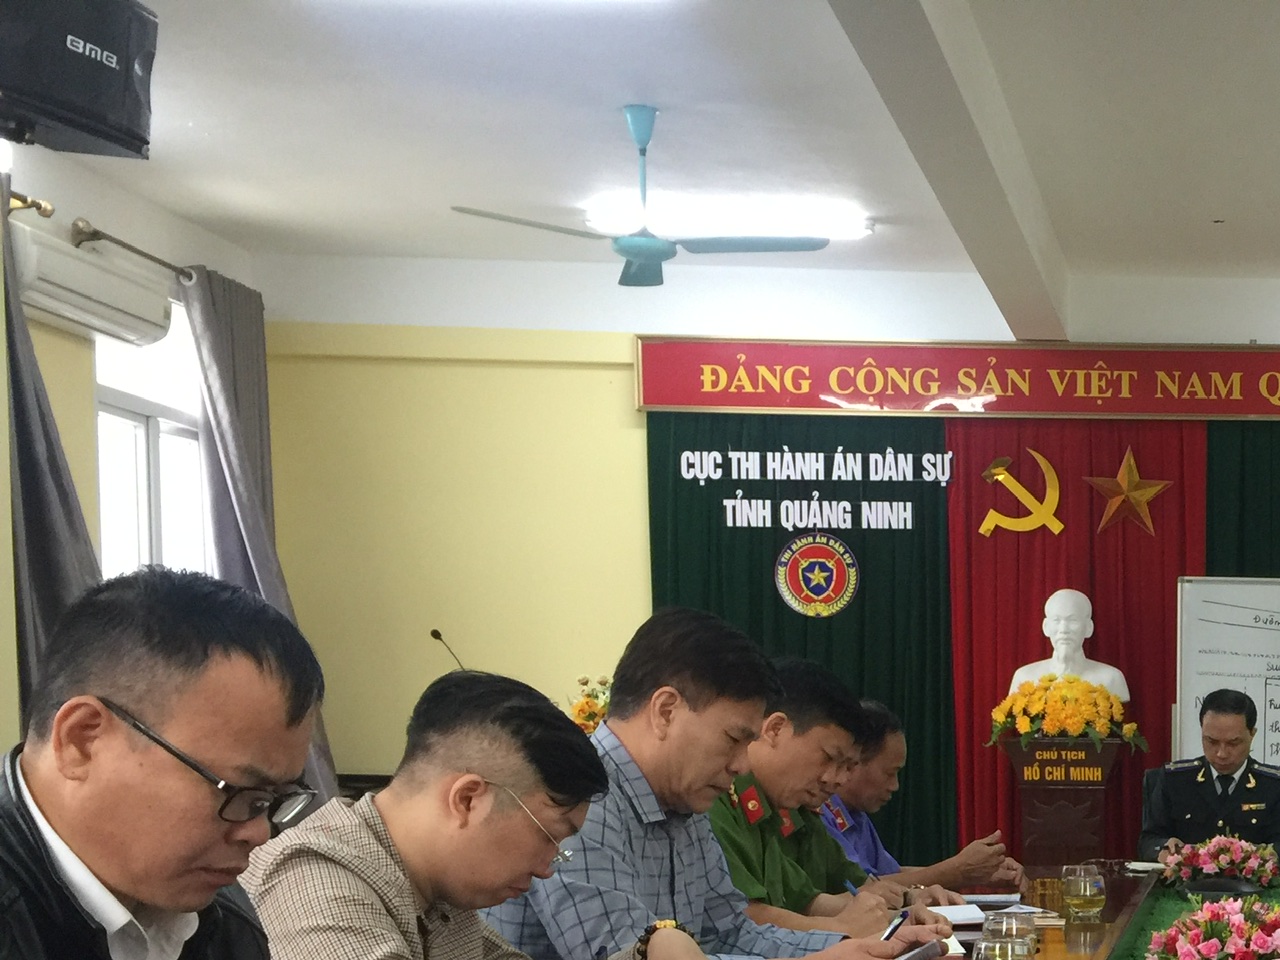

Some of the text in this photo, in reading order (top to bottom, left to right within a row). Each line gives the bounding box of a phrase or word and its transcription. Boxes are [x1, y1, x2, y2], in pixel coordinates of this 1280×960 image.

[701, 353, 811, 394] ĐẢNG
[828, 358, 941, 401] CỘNG
[957, 355, 1031, 397] SẢN
[1048, 361, 1137, 404] VIỆT
[1155, 370, 1243, 400] NAM
[681, 445, 953, 487] CỤC THI HÀNH ÁN DÂN SỰ
[722, 490, 913, 532] TỈNH QUẢNG NINH
[781, 549, 793, 562] THI
[1060, 750, 1086, 761] TỊCH
[1045, 764, 1066, 781] CHÍ
[1070, 767, 1102, 781] MINH
